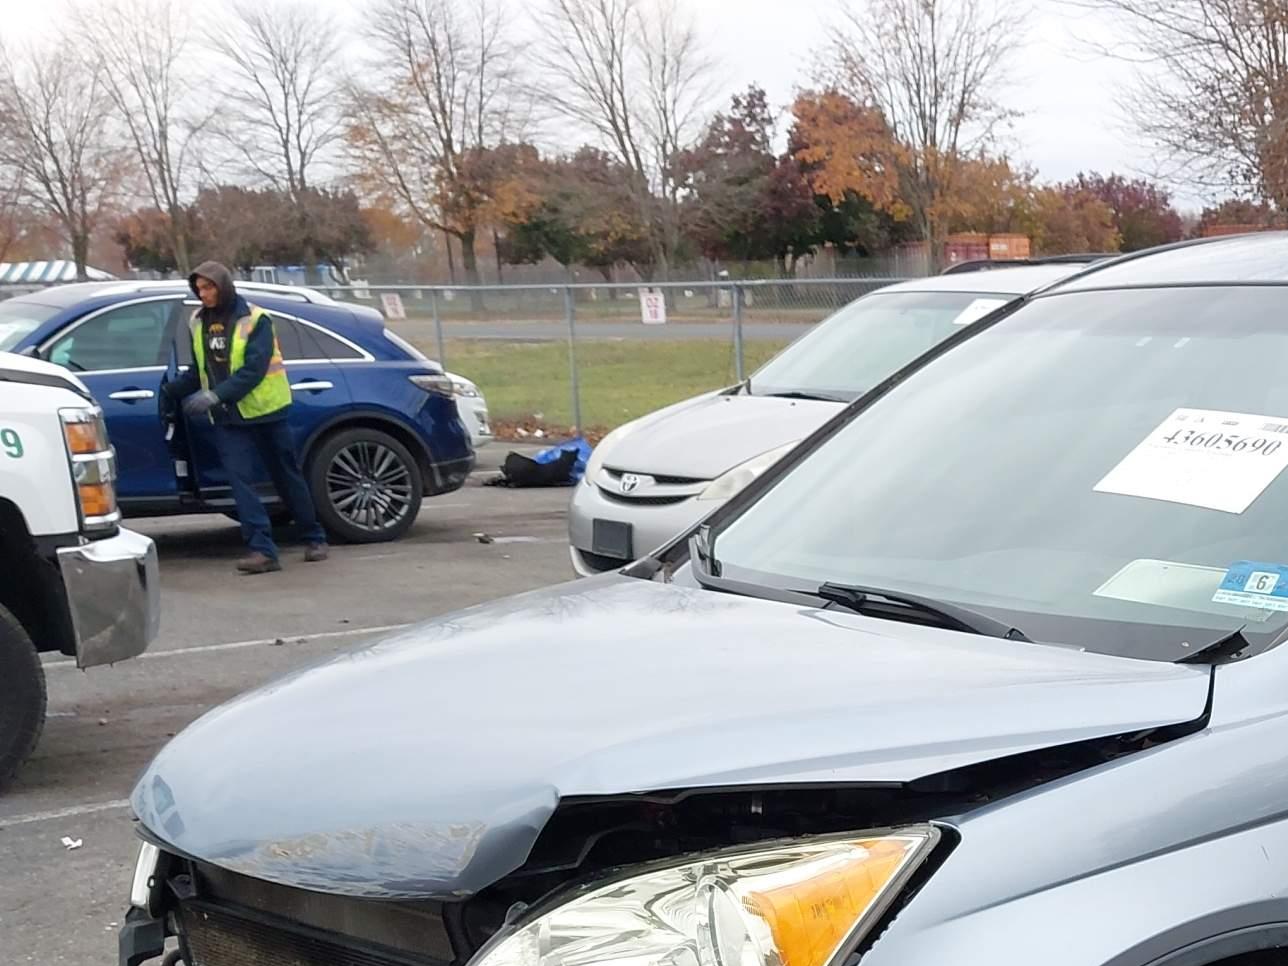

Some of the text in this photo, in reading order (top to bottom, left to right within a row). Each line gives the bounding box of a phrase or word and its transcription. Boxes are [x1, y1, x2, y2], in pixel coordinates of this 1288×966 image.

[1, 428, 24, 459] 9
[1163, 429, 1282, 456] 43605690
[1256, 575, 1269, 591] 6
